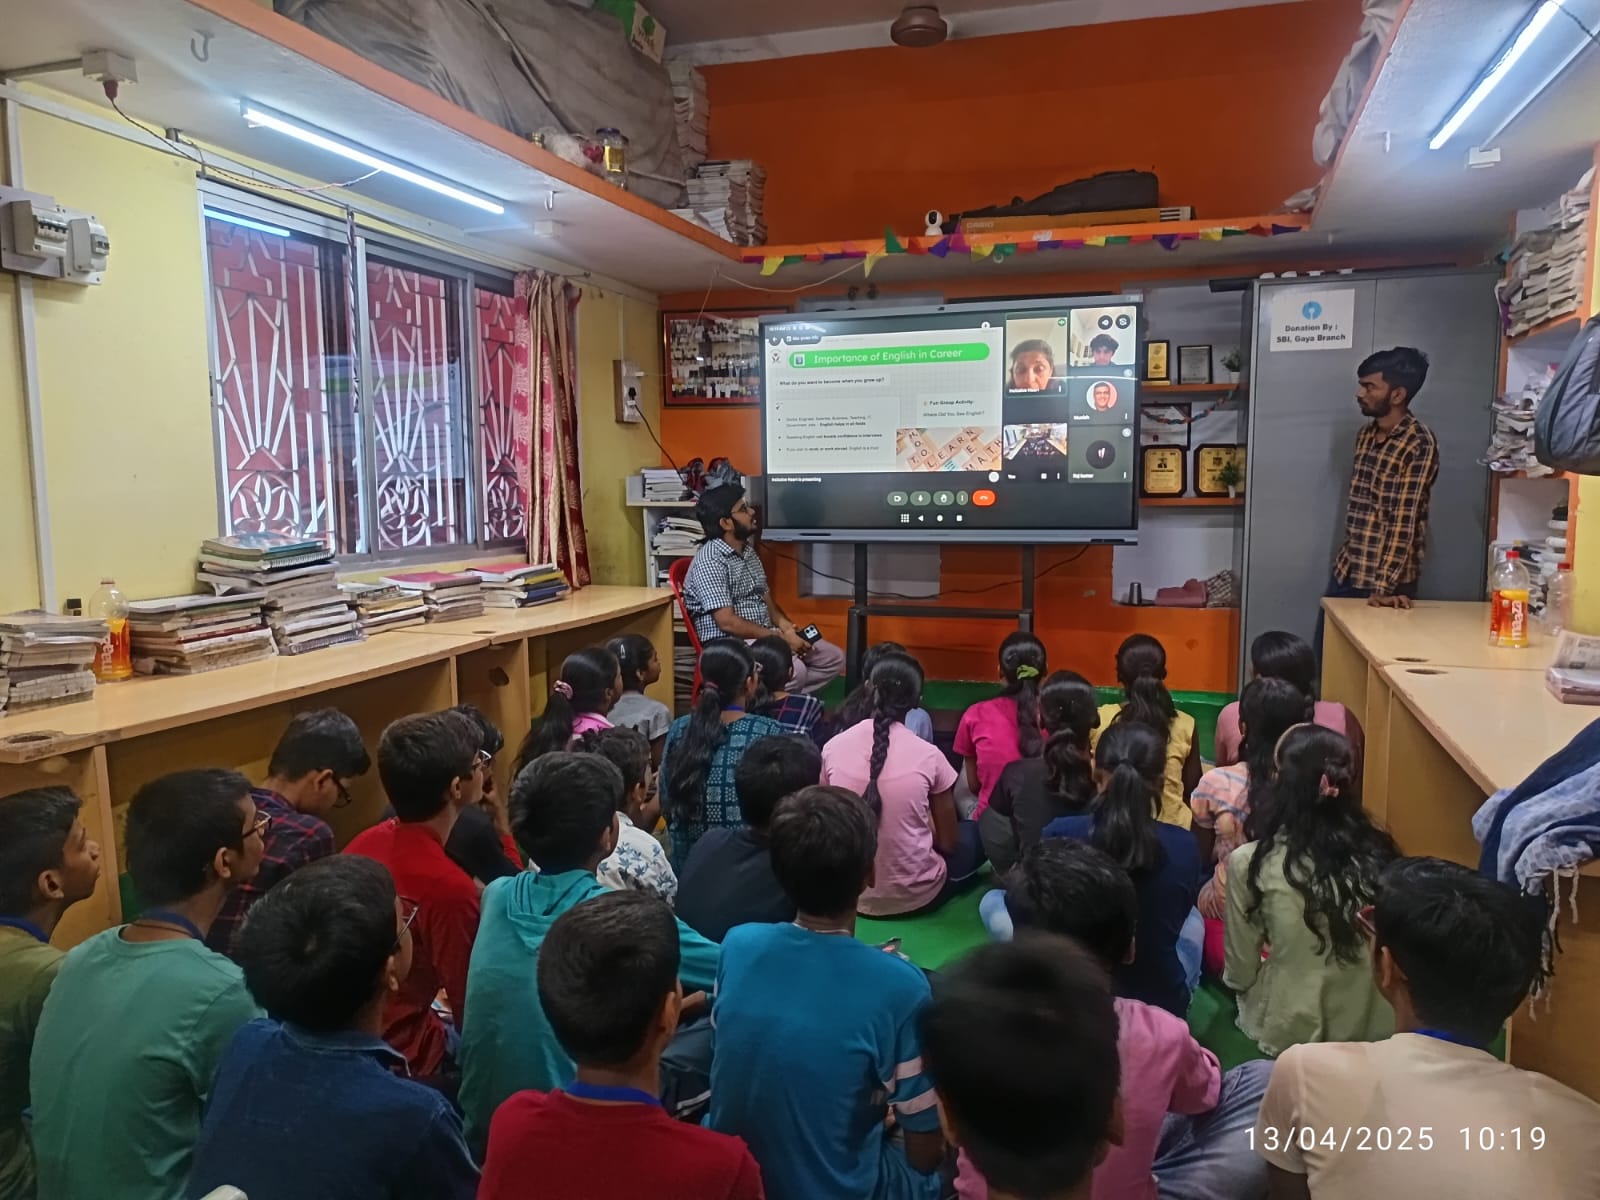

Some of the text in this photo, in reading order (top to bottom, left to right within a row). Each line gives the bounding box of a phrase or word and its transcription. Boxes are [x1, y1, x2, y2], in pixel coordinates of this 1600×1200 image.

[1285, 324, 1320, 332] Donation
[1322, 323, 1333, 332] By
[1294, 335, 1315, 343] Gaya
[813, 349, 963, 365] Importance of English in Career
[1511, 600, 1523, 641] maaza
